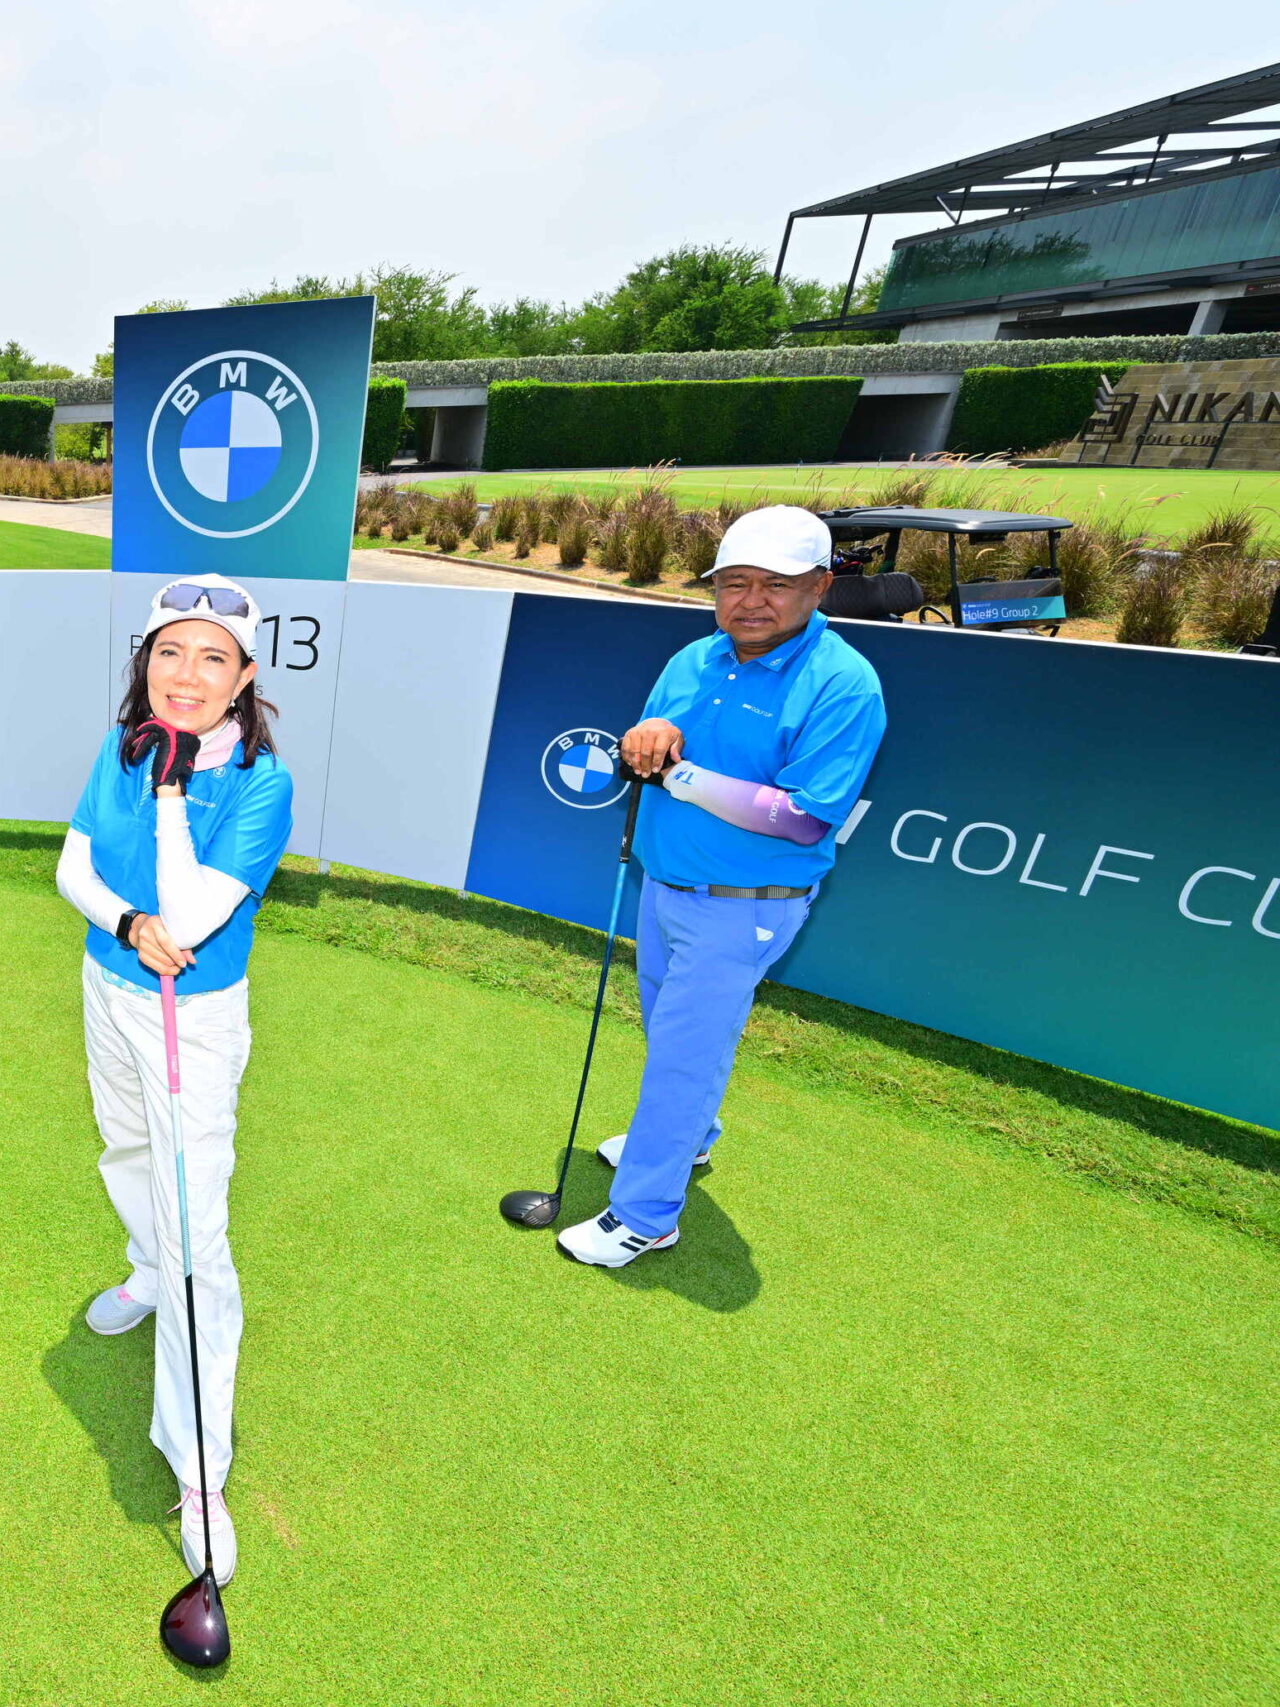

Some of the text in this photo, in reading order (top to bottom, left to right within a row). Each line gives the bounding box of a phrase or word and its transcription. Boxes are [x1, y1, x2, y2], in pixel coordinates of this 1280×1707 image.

[171, 361, 298, 416] BMW
[1001, 607, 1030, 619] Group
[1032, 605, 1038, 616] 2
[255, 614, 321, 671] 13
[558, 732, 620, 760] BMW
[769, 801, 780, 824] GOLF
[890, 809, 1155, 897] GOLF
